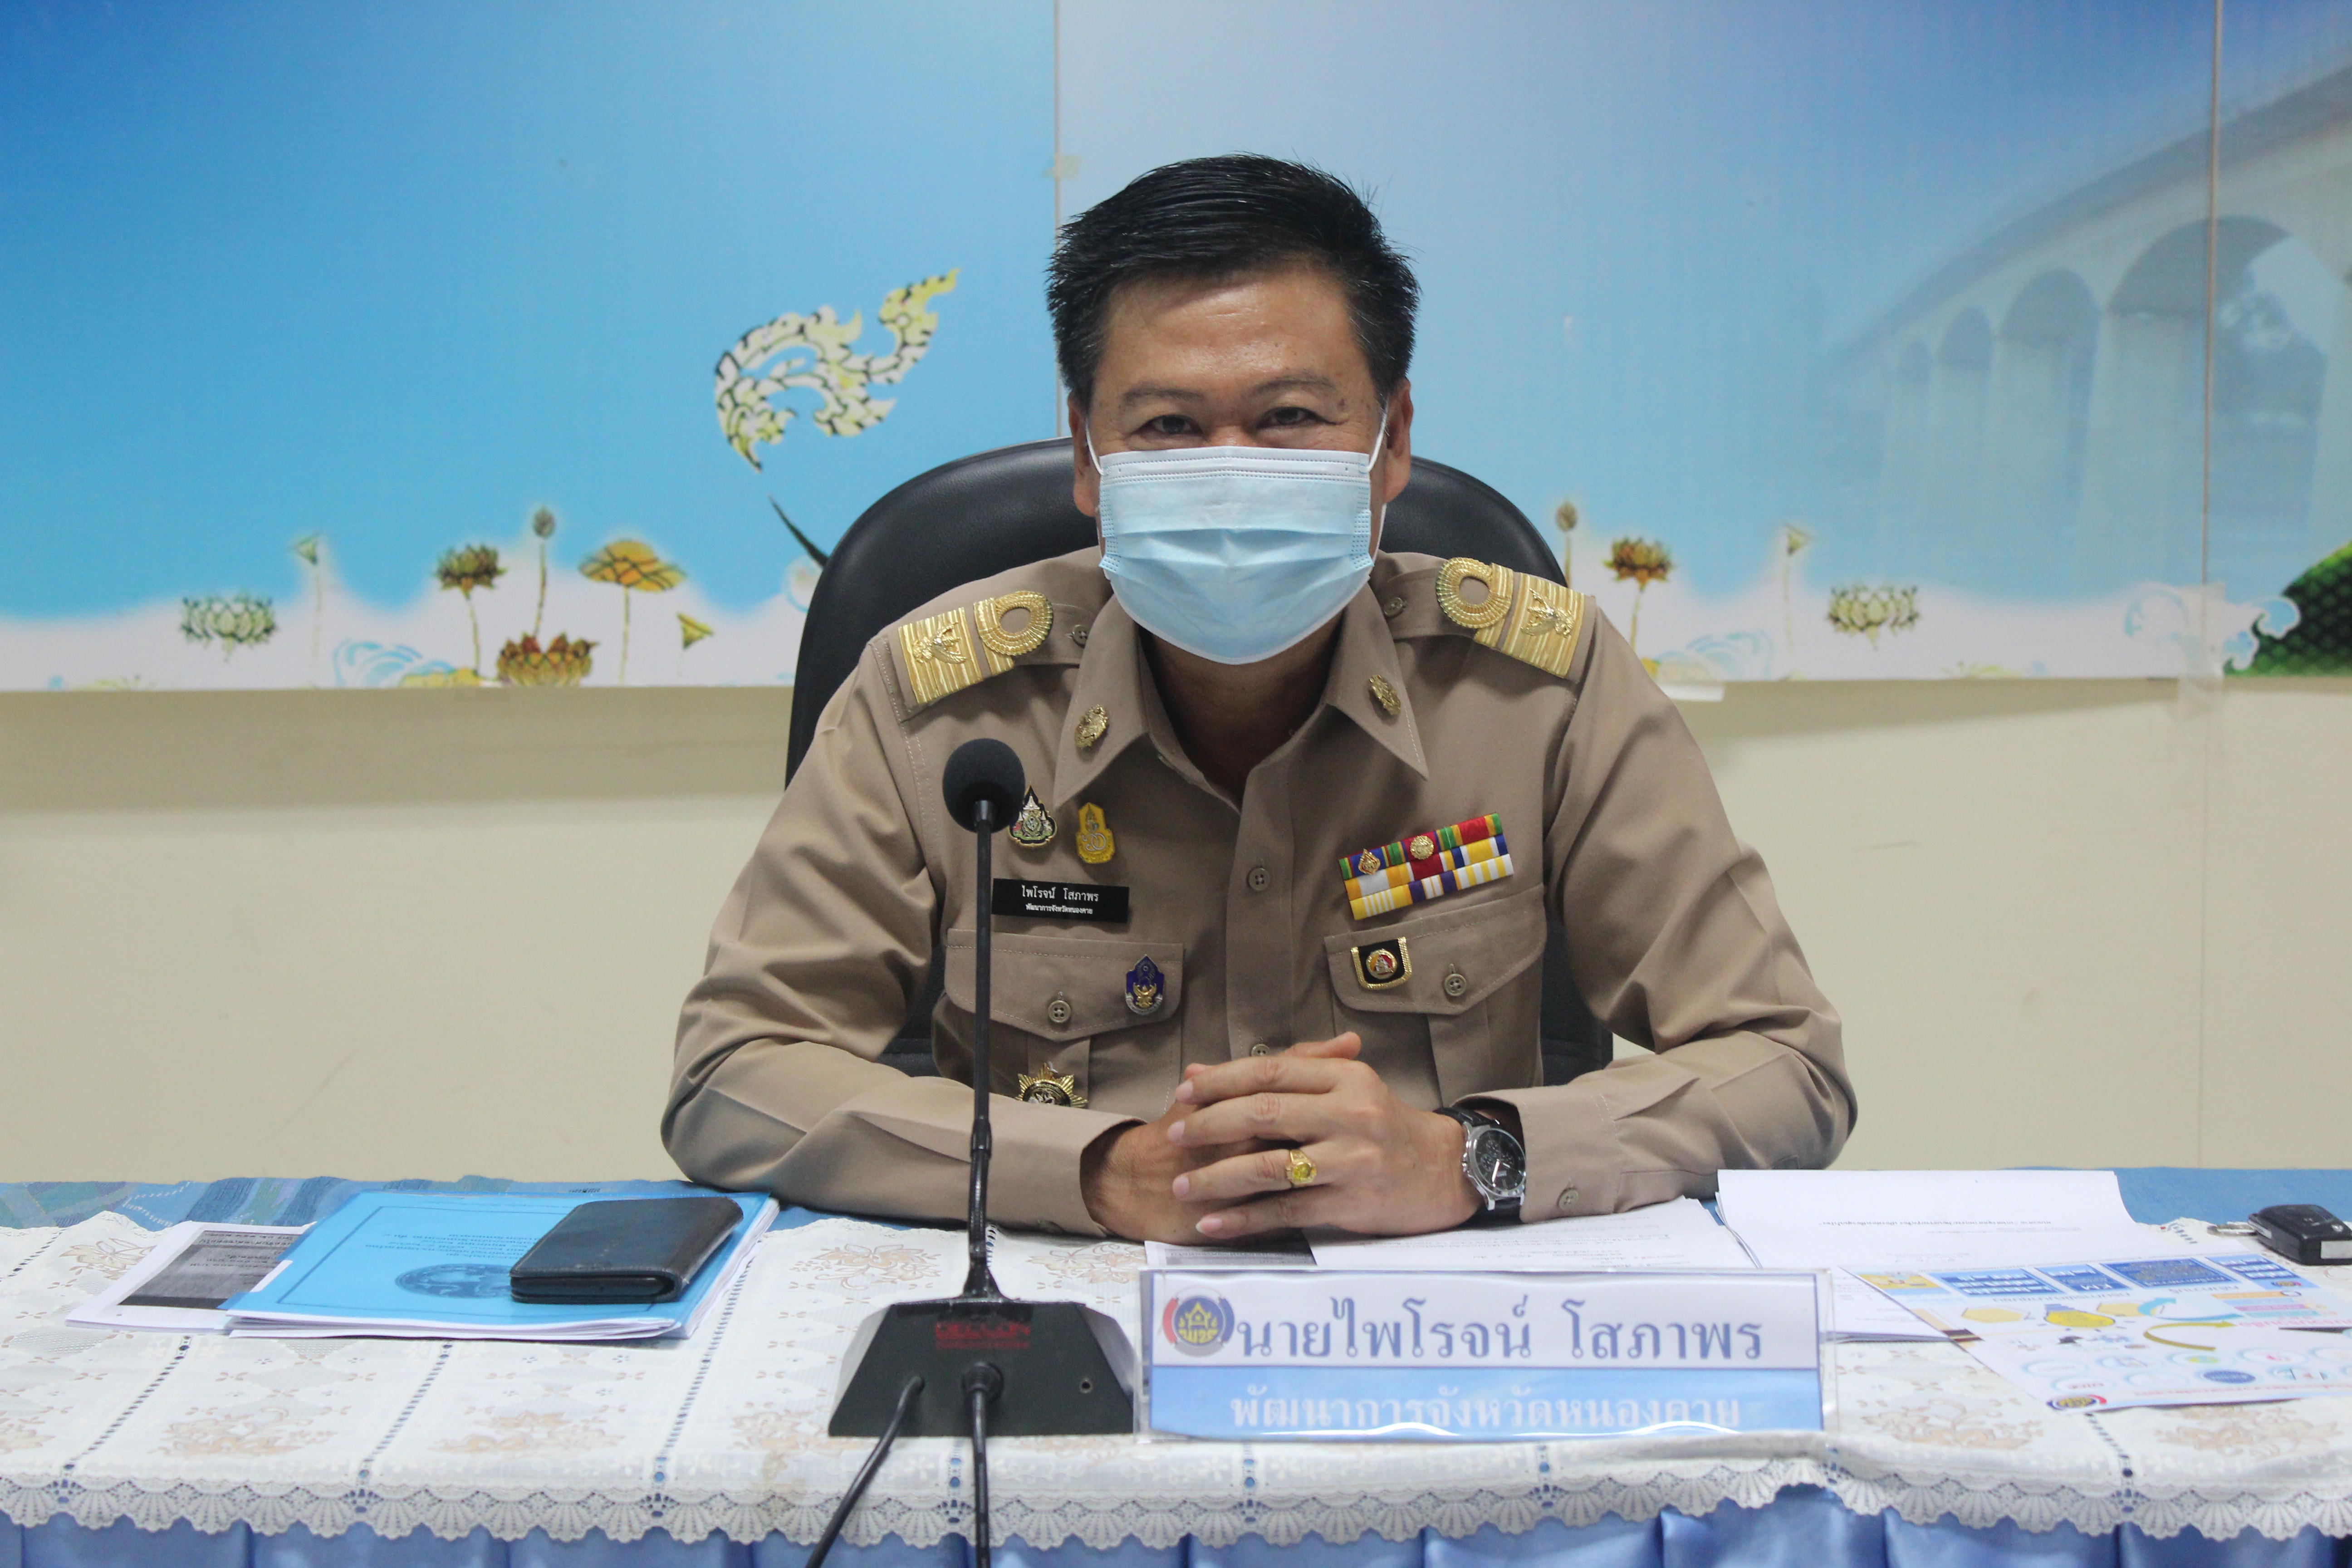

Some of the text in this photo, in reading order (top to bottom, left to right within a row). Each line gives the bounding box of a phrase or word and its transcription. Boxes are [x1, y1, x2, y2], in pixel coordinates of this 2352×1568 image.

[1022, 885, 1099, 902] ไพโรจน์ โสภาพร
[1237, 1294, 1762, 1359] นายไพโรจน์ โสภาพร
[1230, 1384, 1740, 1428] พัฒนาการจังหวัดหนองคาย
